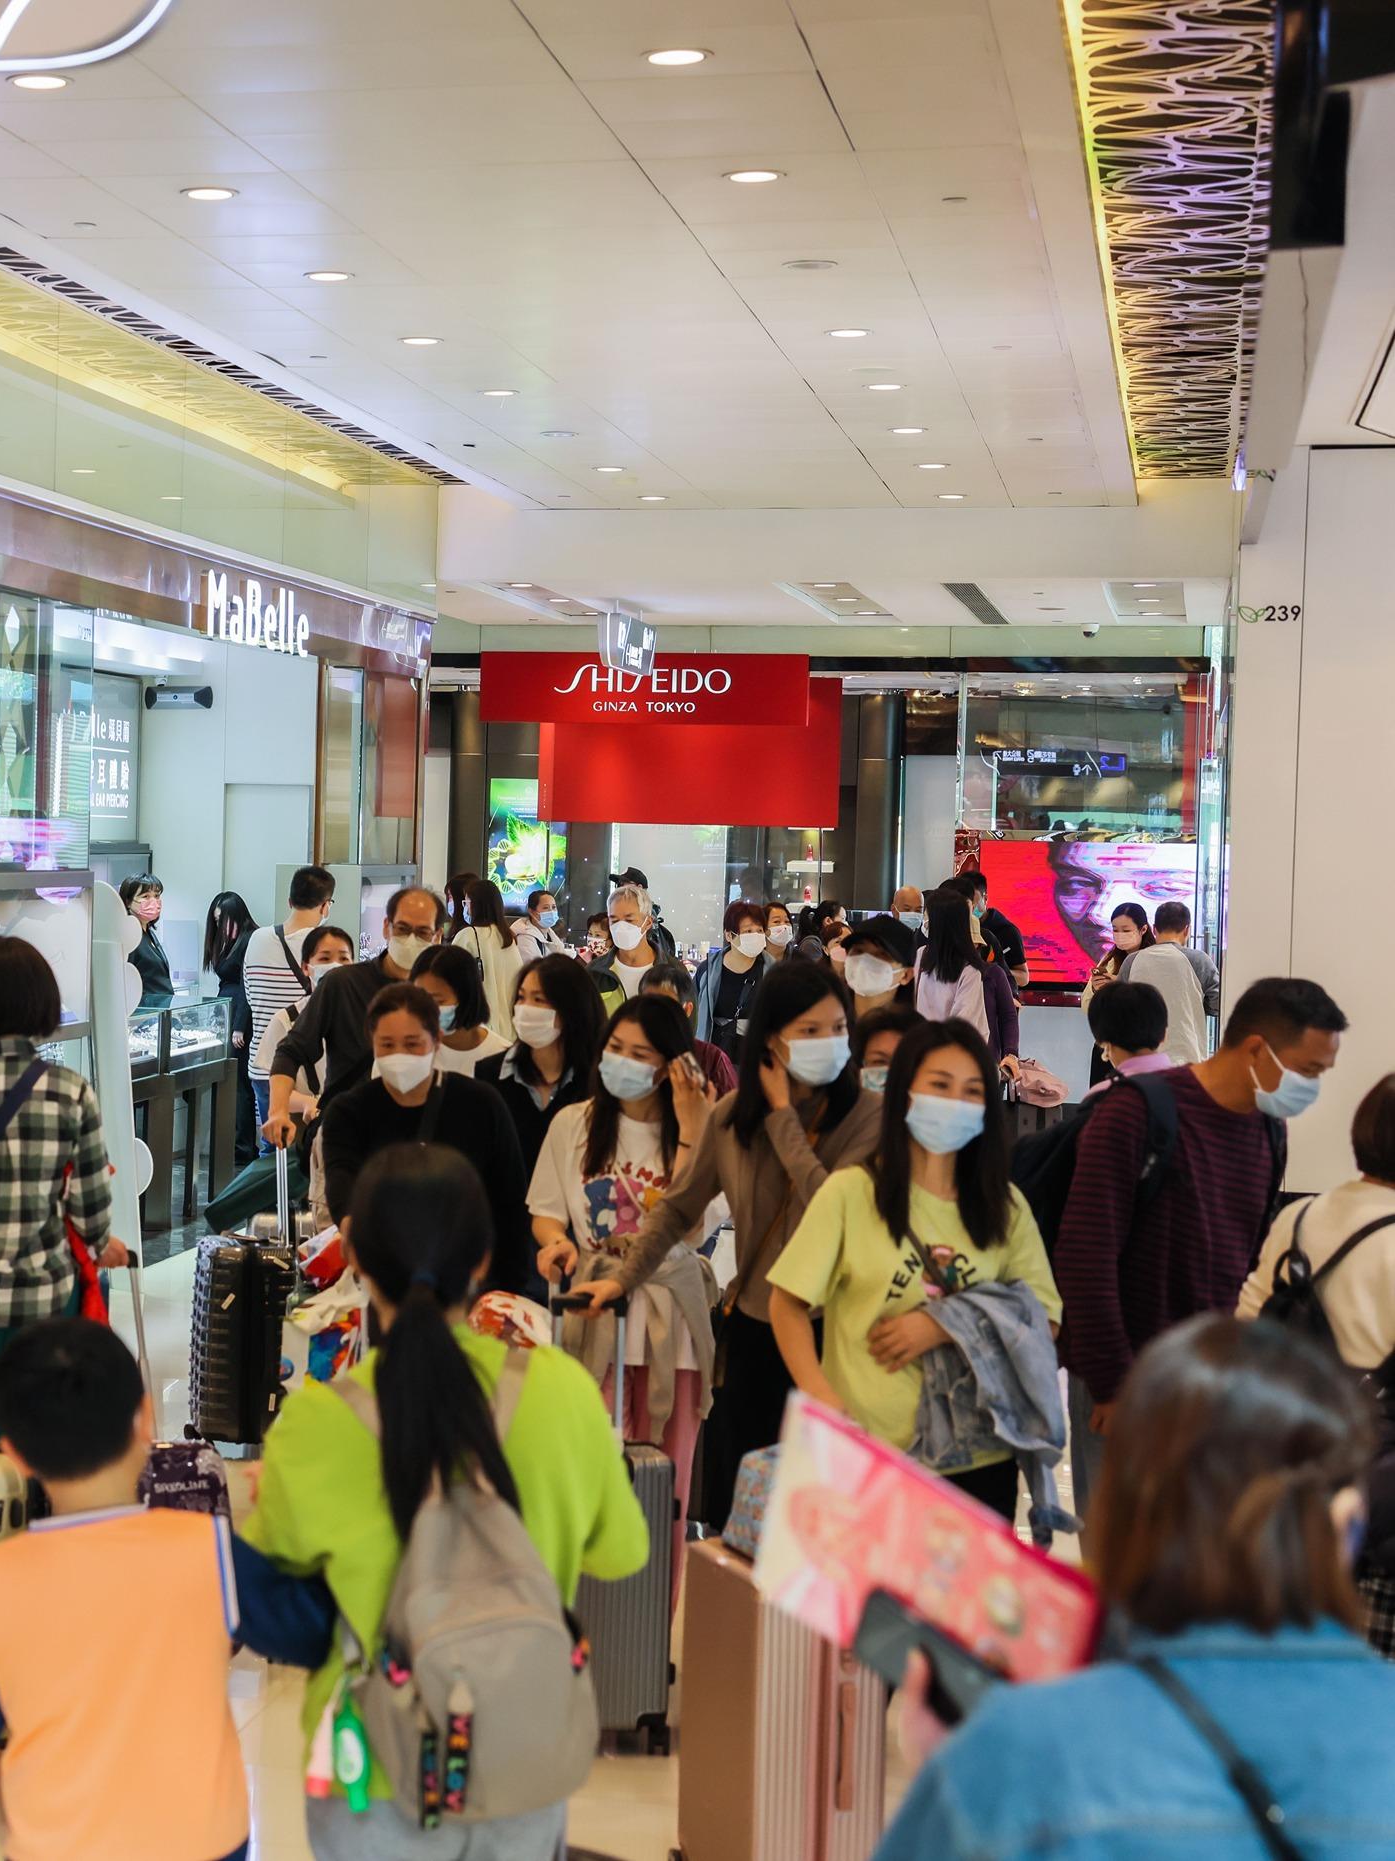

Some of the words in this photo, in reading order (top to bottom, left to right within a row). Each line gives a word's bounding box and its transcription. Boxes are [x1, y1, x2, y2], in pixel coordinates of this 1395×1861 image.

[207, 568, 309, 658] MaBelle
[1265, 605, 1301, 621] 239
[593, 701, 637, 712] GINZA
[646, 702, 696, 713] TOKYO
[91, 758, 130, 790] 耳體驗
